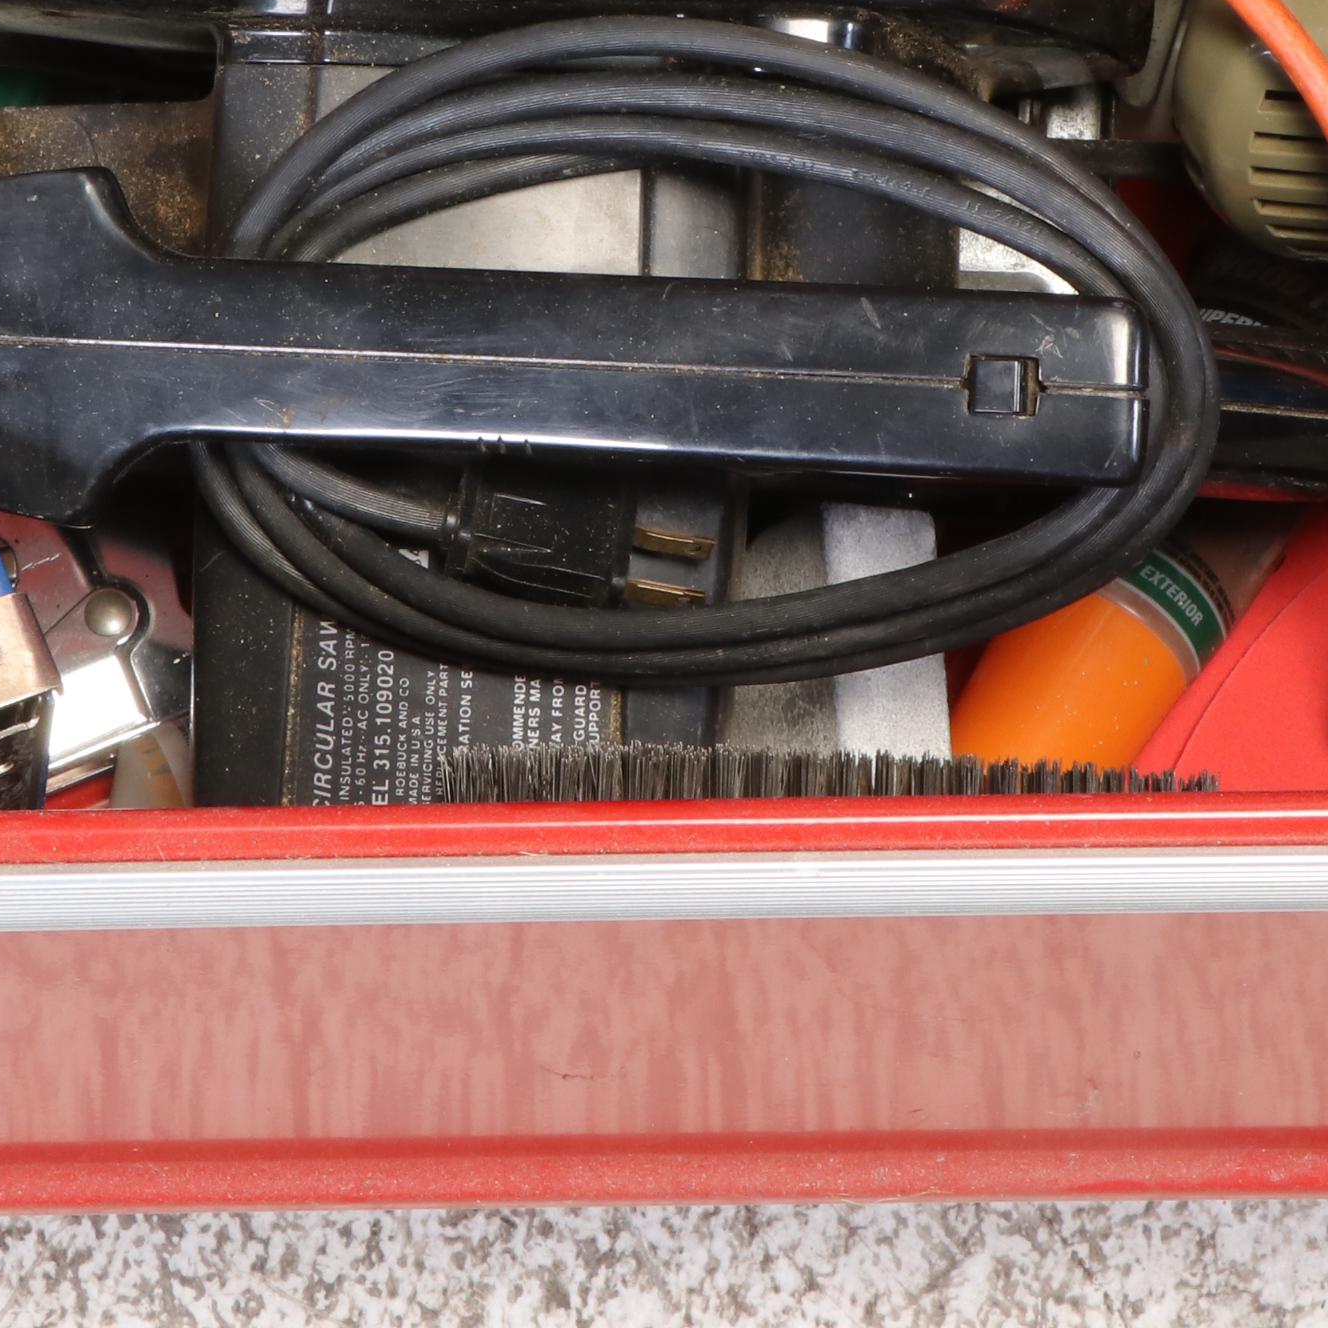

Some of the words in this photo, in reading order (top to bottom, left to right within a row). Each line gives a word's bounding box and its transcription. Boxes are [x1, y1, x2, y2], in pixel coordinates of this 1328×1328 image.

[1139, 564, 1205, 628] EXTERIOR
[343, 662, 356, 703] 5000
[357, 665, 370, 707] ONLY
[425, 669, 437, 706] ONLY
[356, 712, 370, 730] AC
[373, 649, 395, 774] 315.109020
[397, 702, 410, 729] AND
[424, 707, 436, 732] USE
[573, 683, 587, 743] GUARD
[338, 714, 355, 801] INSULATED
[395, 746, 408, 797] ROEBUCK
[409, 750, 420, 765] IN
